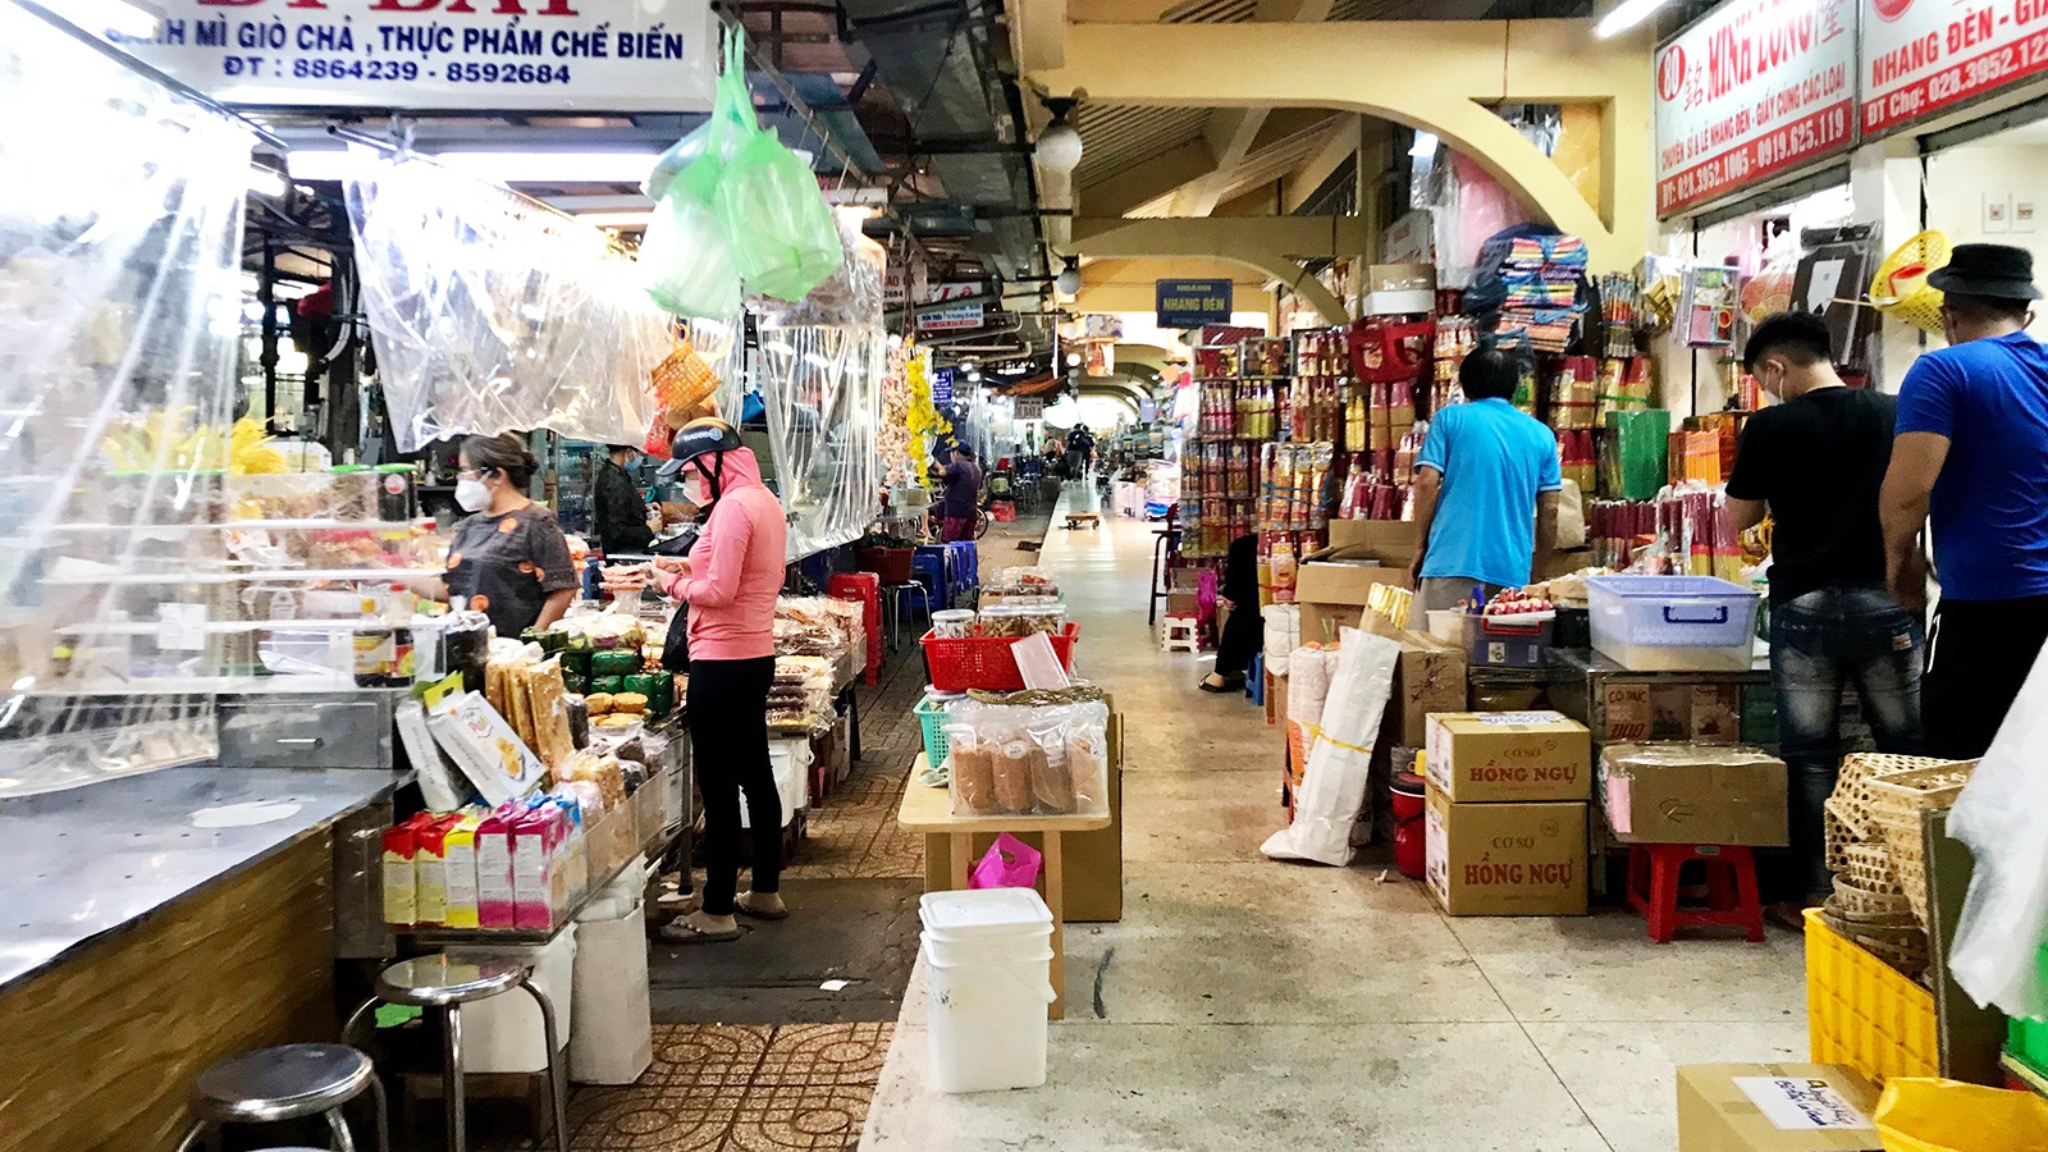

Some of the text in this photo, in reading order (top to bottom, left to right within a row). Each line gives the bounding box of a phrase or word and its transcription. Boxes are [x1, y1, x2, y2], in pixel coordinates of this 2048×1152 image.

[196, 14, 226, 47] MÌ
[238, 15, 287, 50] GIÒ
[296, 15, 354, 52] CHẢ
[379, 21, 454, 59] THỰC
[463, 16, 543, 57] PHẨM
[551, 22, 609, 58] CHẾ
[617, 23, 683, 59] BIẾN
[1708, 0, 1813, 103] MINH LONG
[1872, 31, 1939, 88] NHANG
[1946, 5, 1993, 55] ĐÈN
[224, 56, 263, 77] ĐT
[293, 59, 418, 81] 8864239
[447, 62, 571, 84] 8592684
[1867, 98, 1886, 127] ĐT
[1889, 86, 1925, 118] Chợ:
[1757, 107, 1845, 169] 0919.625.119
[1163, 297, 1200, 312] NHANG
[1469, 759, 1529, 783] HỒNG
[1533, 762, 1578, 784] NGỰ
[1528, 858, 1574, 890] NGỰ
